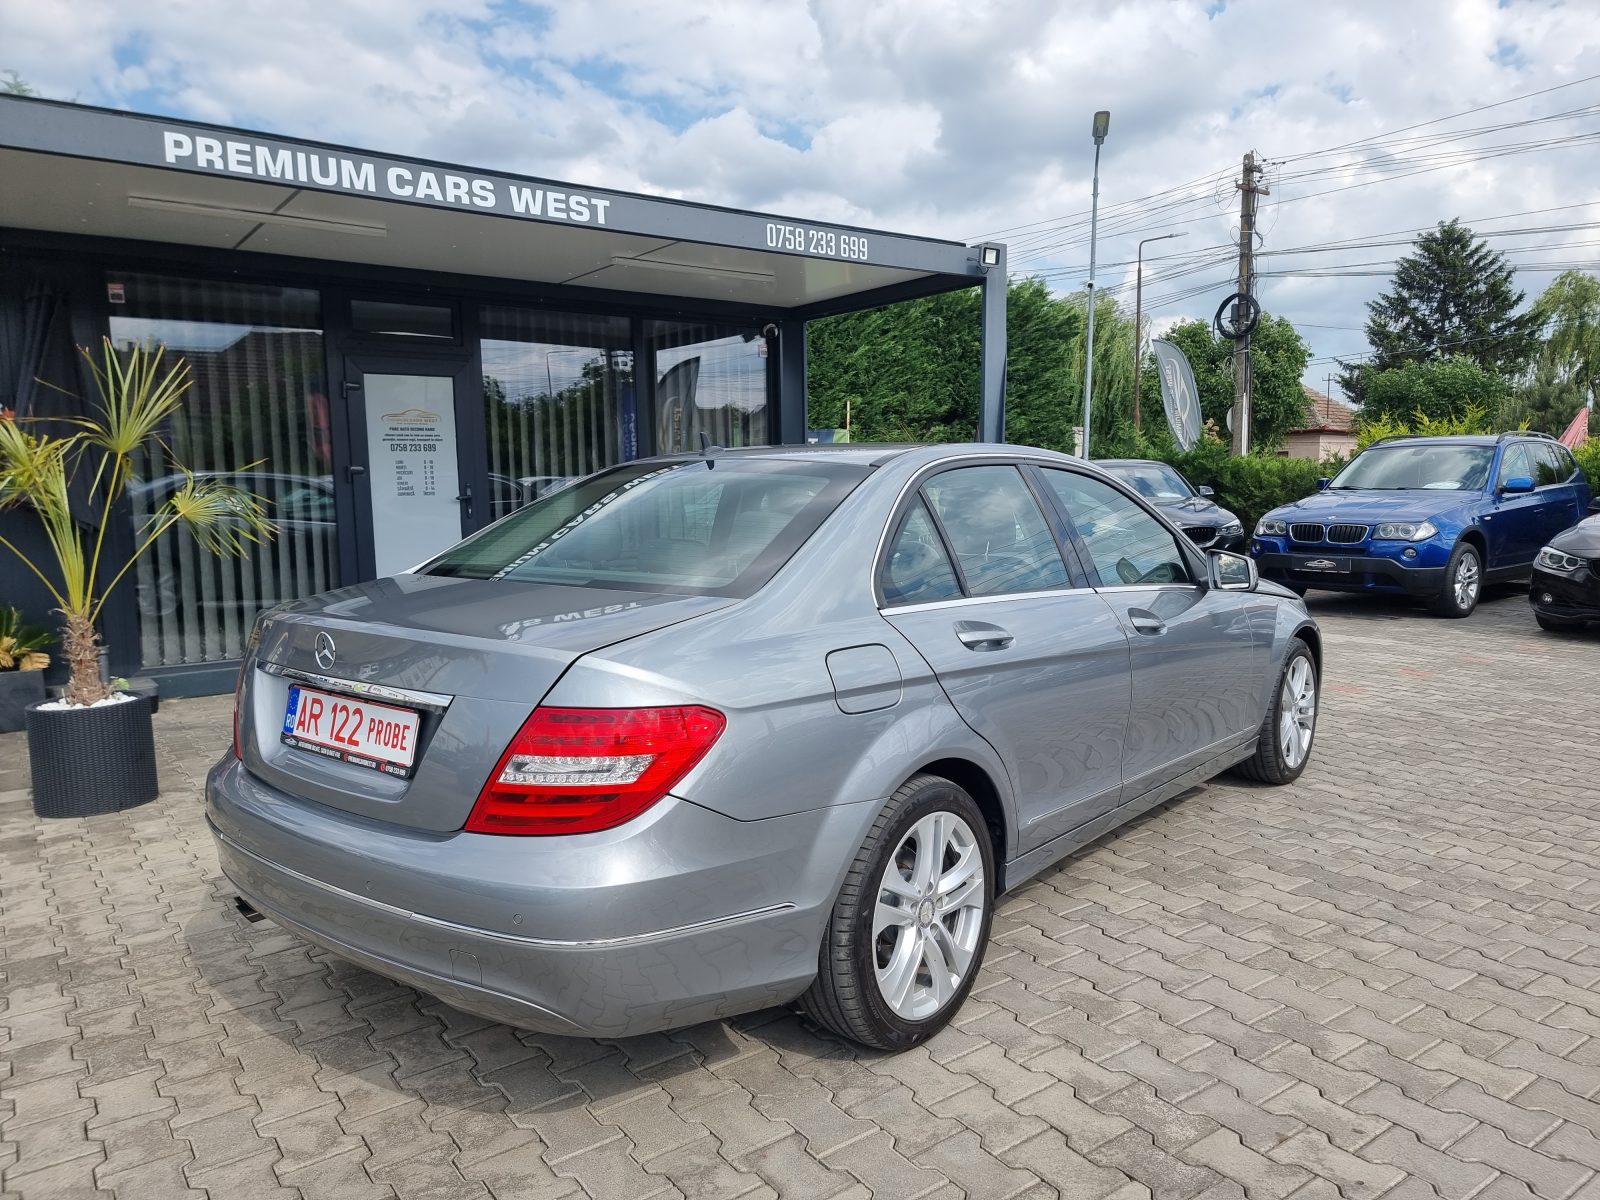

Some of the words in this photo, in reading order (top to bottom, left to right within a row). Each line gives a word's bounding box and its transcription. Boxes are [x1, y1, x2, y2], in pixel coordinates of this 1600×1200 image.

[163, 131, 377, 192] PREMIUM
[387, 166, 496, 208] CARS
[509, 185, 610, 225] WEST
[766, 223, 805, 251] 0758
[808, 230, 836, 256] 233
[840, 235, 868, 260] 699
[285, 713, 296, 728] RO
[296, 695, 324, 736] AR
[329, 702, 364, 747] 122
[367, 717, 411, 751] PROBE
